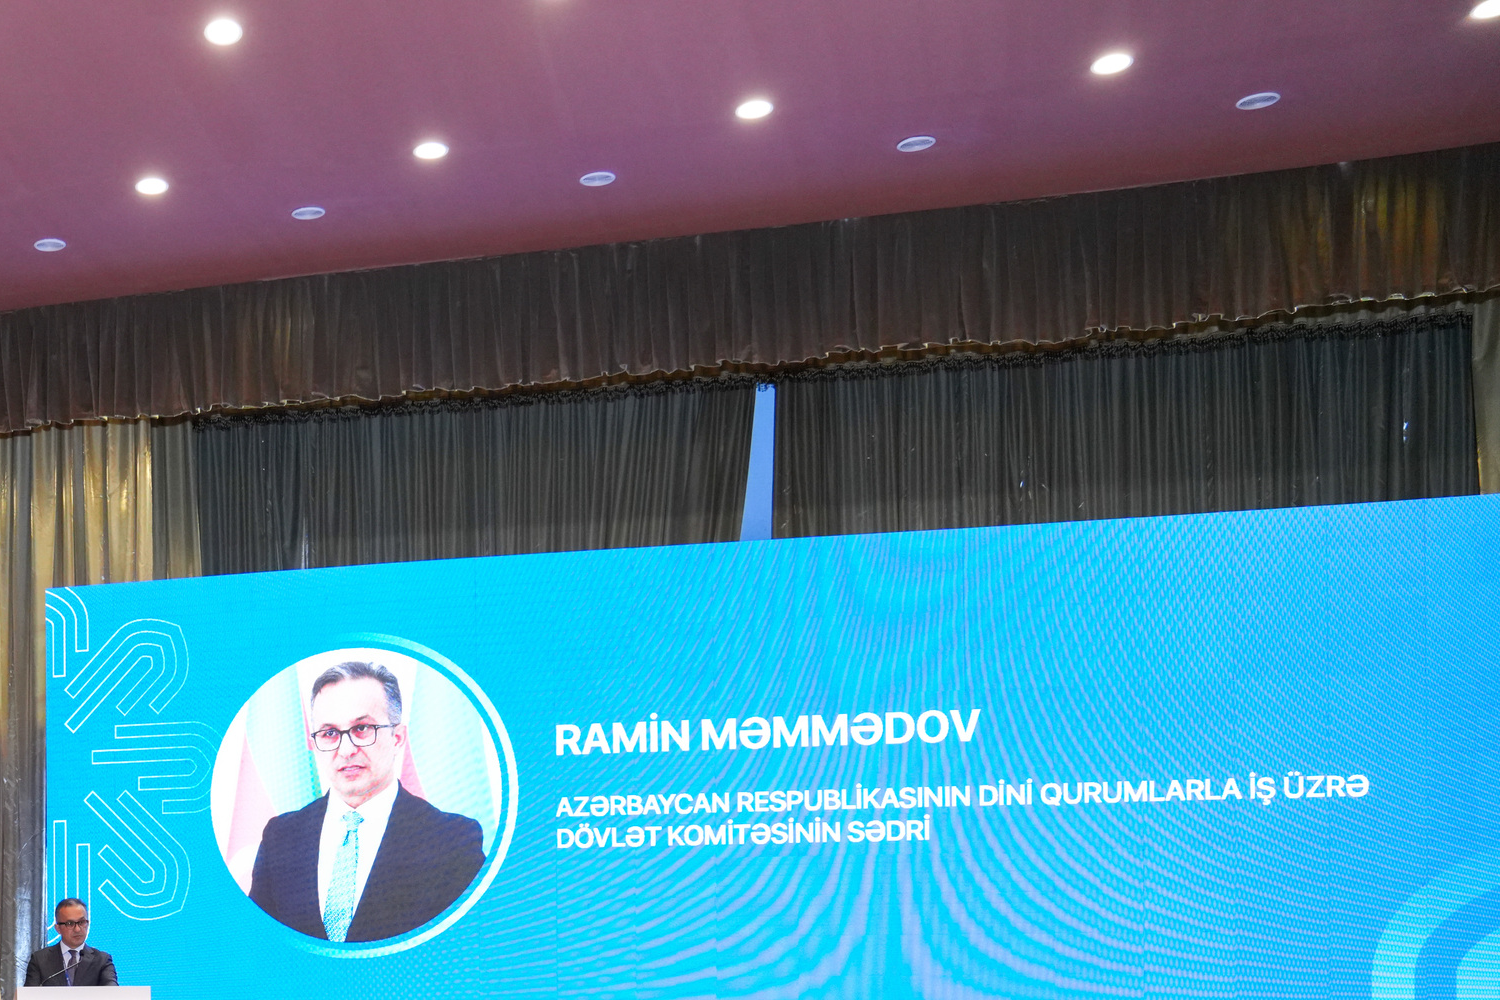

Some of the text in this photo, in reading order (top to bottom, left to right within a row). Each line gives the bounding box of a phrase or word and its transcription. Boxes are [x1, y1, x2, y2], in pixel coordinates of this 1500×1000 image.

[555, 708, 981, 756] RAMİN MƏMMƏDOV
[555, 771, 1370, 818] AZƏRBAYCAN RESPUBLİKASININ DİNİ QURUMLARLA İŞ ÜZRƏ
[556, 814, 931, 849] DÖVLƏT KOMİTƏSİNİN SƏDRİ
